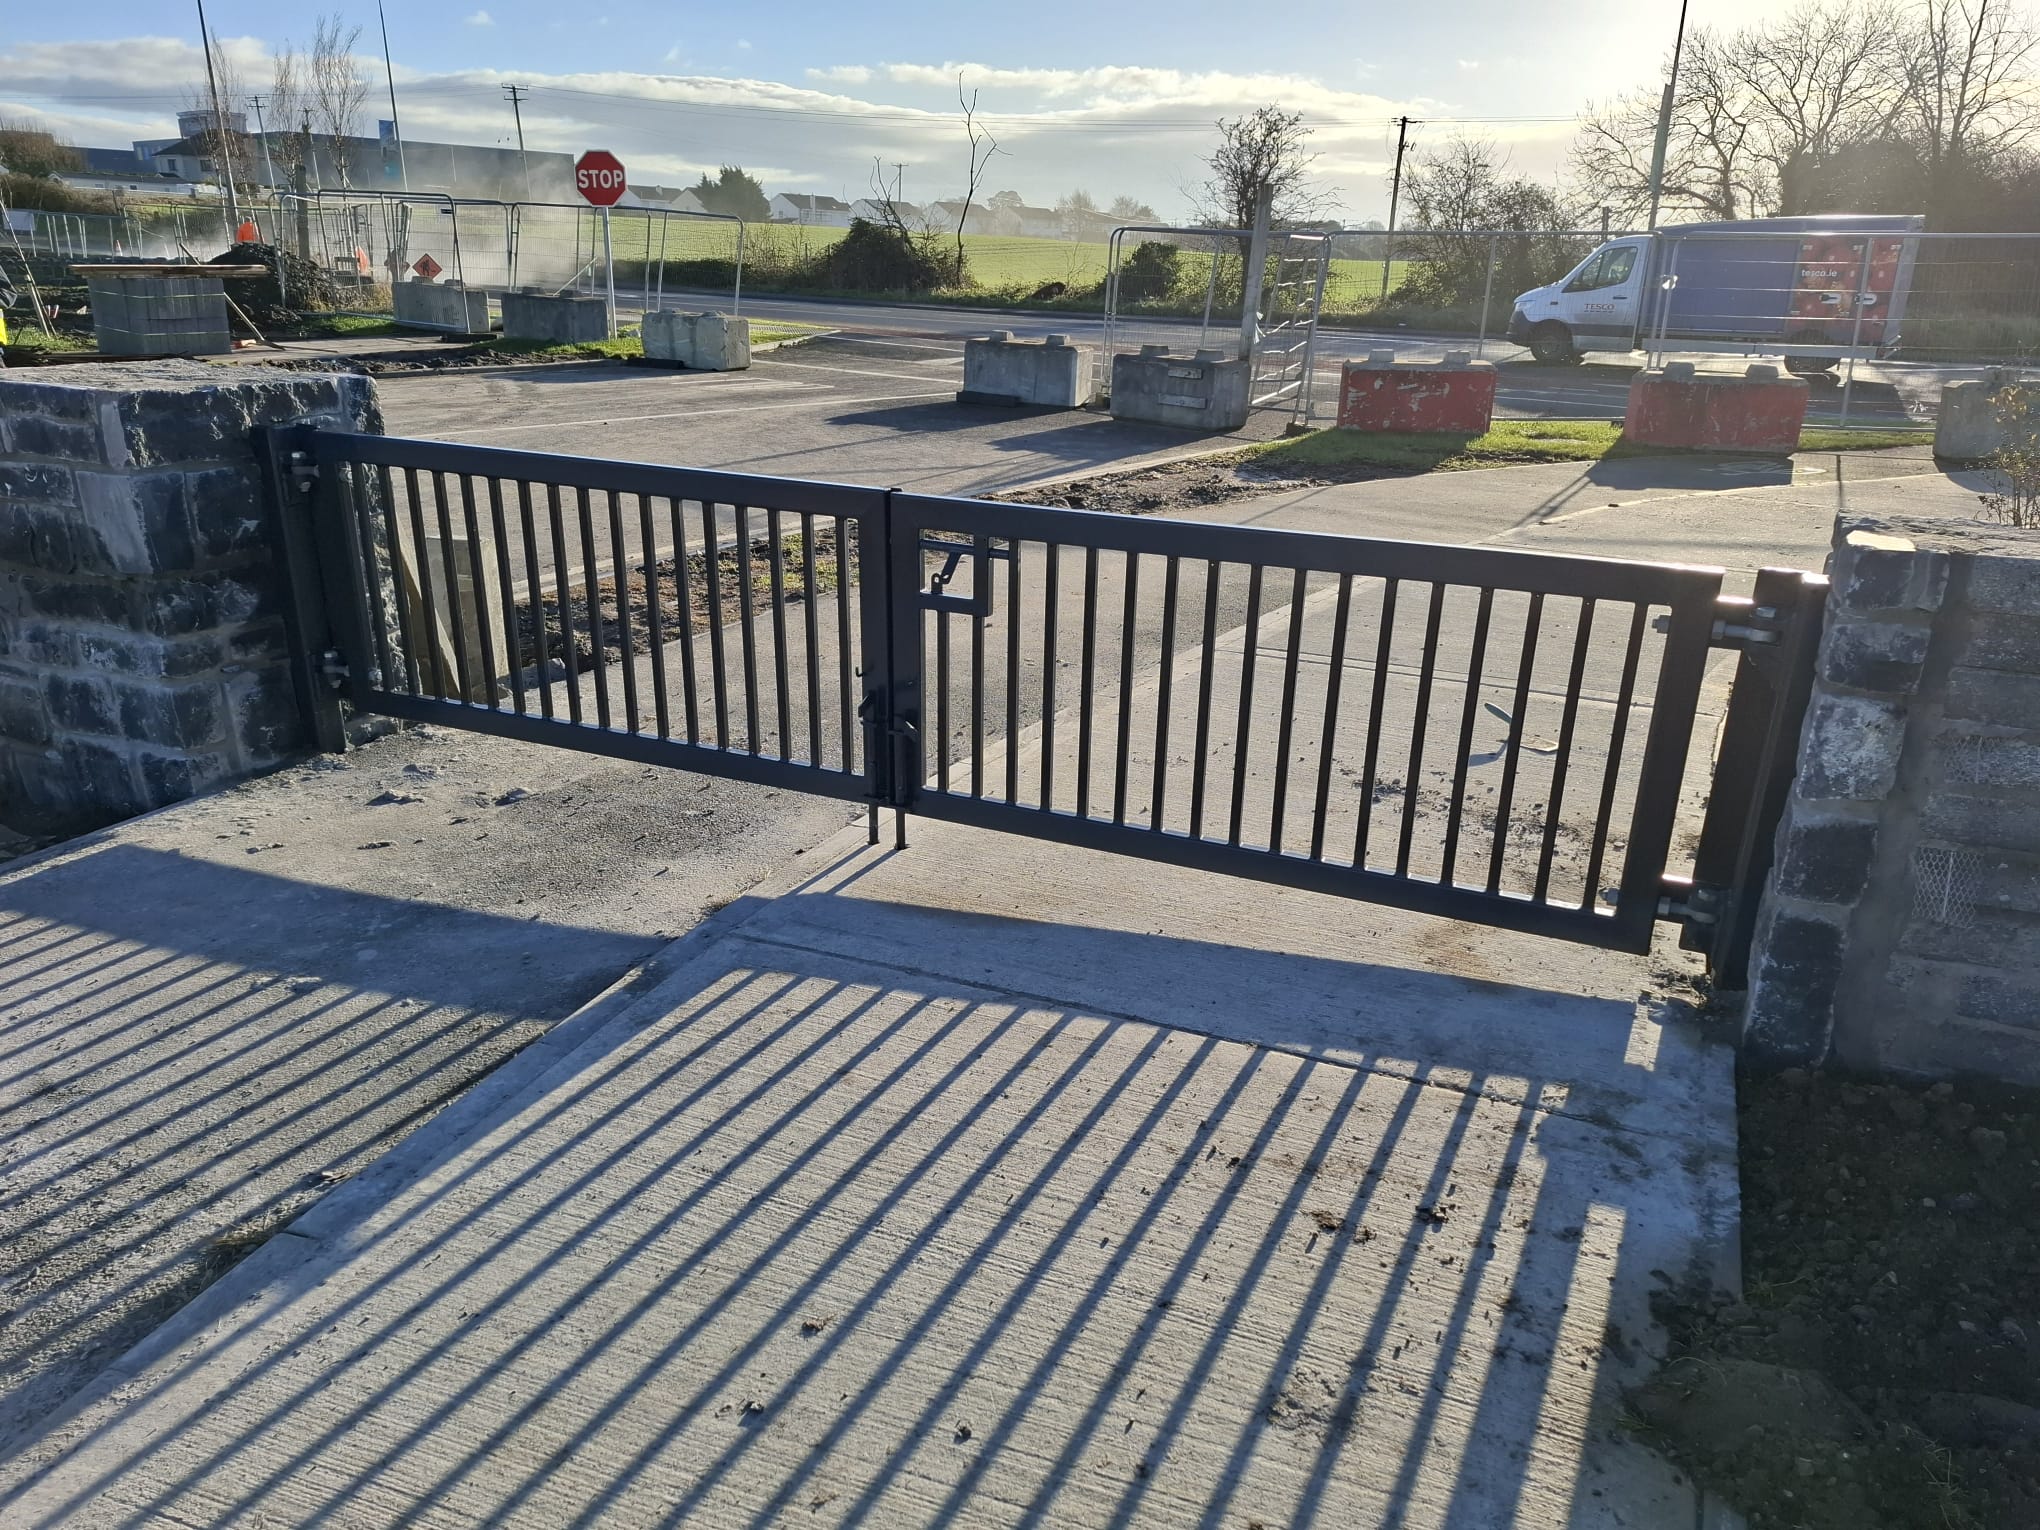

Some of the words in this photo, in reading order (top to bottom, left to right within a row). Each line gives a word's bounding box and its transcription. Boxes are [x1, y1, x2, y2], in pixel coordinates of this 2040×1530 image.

[577, 169, 623, 189] STOP
[1801, 268, 1838, 277] tesco.ie
[1584, 303, 1615, 311] TESCO
